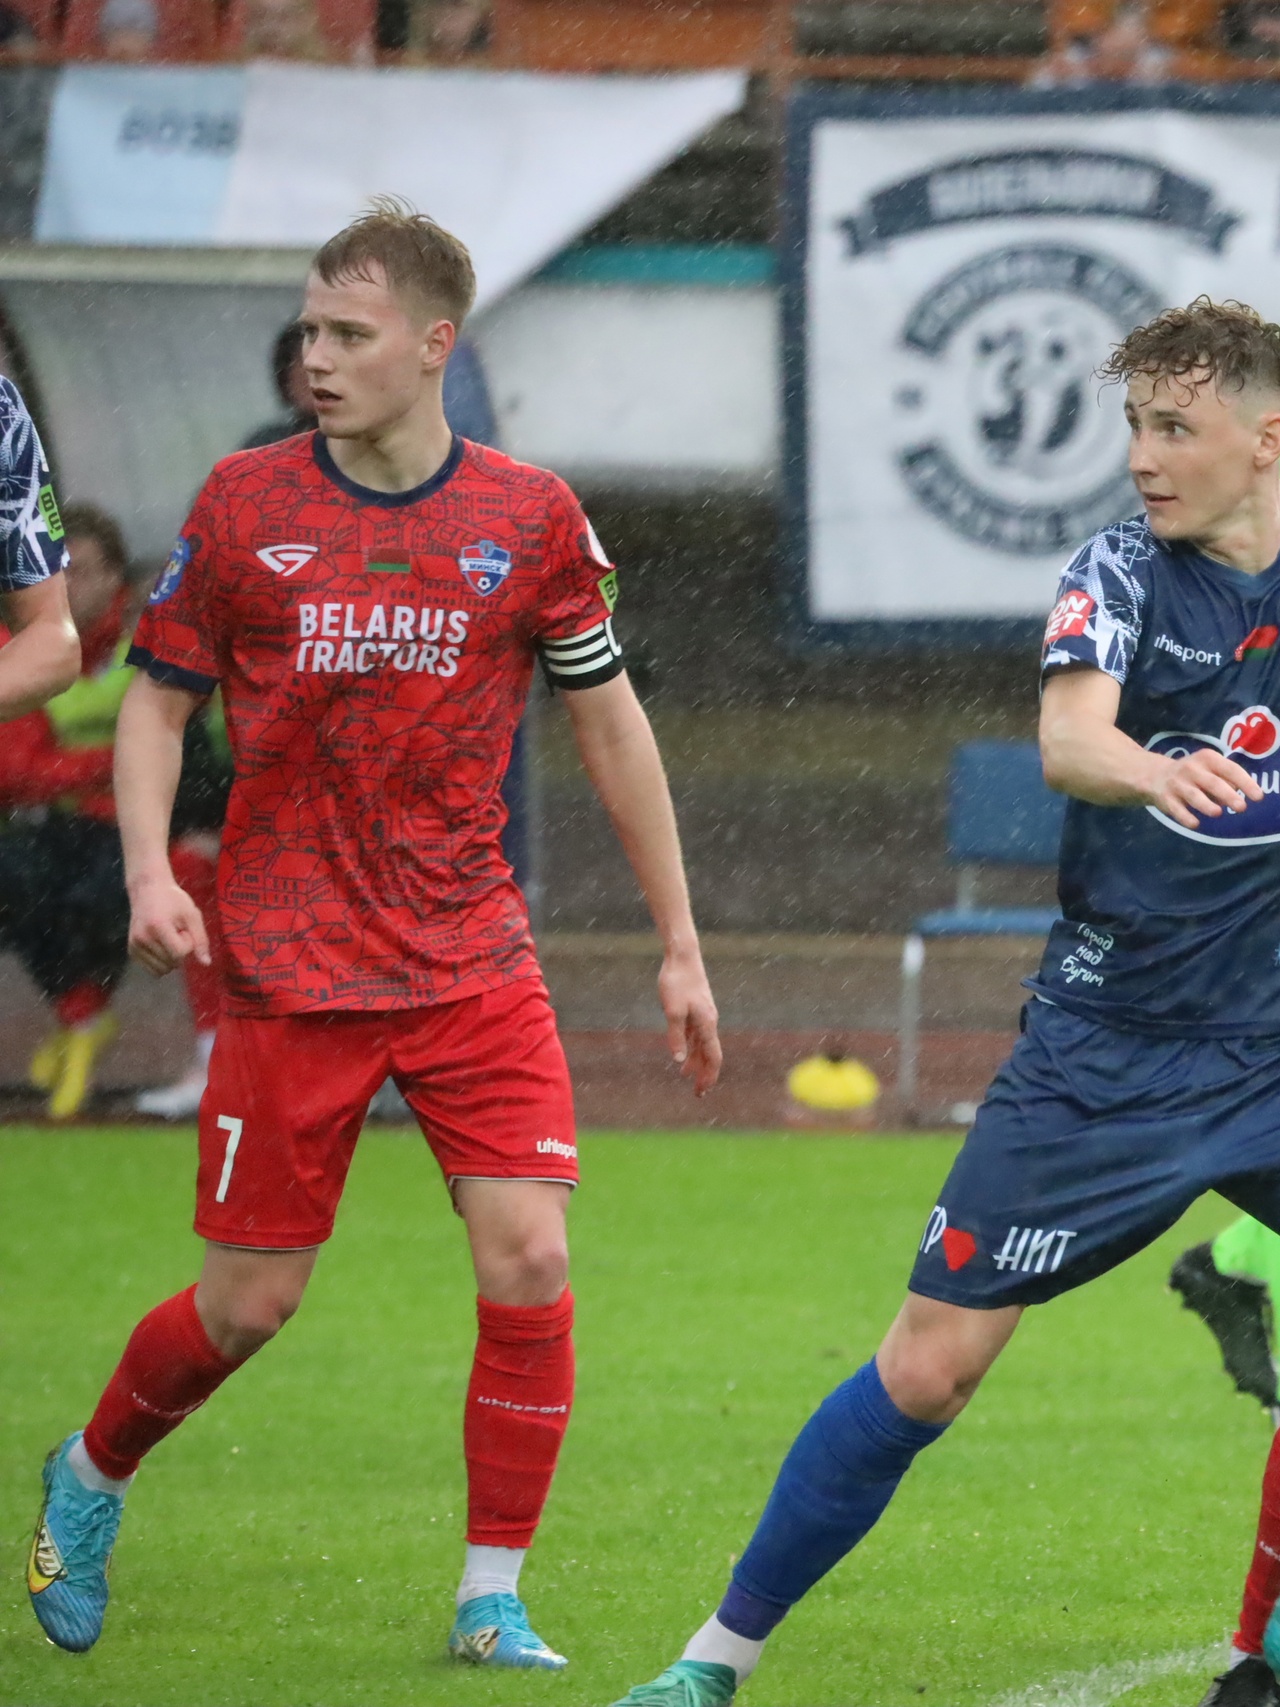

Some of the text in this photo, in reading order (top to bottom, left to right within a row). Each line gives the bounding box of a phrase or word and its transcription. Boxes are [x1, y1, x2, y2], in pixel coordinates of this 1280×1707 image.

[468, 563, 502, 572] МИНСК
[299, 603, 470, 645] BELARUS
[1045, 611, 1084, 643] ET
[1047, 595, 1089, 627] ON
[296, 640, 461, 677] TRACTORS
[1060, 955, 1104, 987] Бугом
[1076, 944, 1104, 966] над
[216, 1114, 243, 1203] 7
